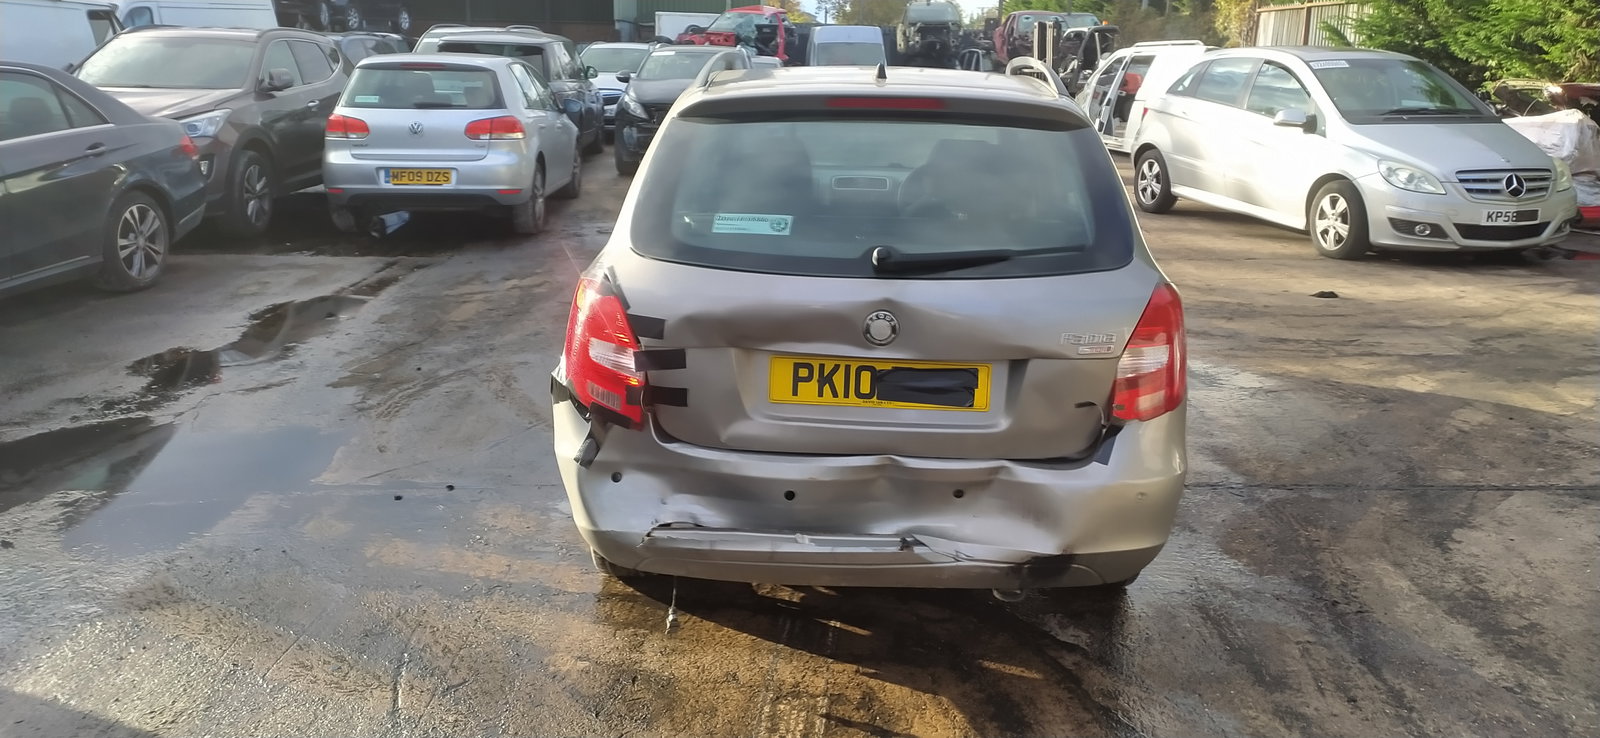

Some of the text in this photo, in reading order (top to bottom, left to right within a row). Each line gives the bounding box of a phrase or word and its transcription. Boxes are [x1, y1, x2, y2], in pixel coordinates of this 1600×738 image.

[391, 171, 450, 182] MF09 DZS
[1486, 210, 1518, 222] KP58
[791, 361, 877, 400] PK10
